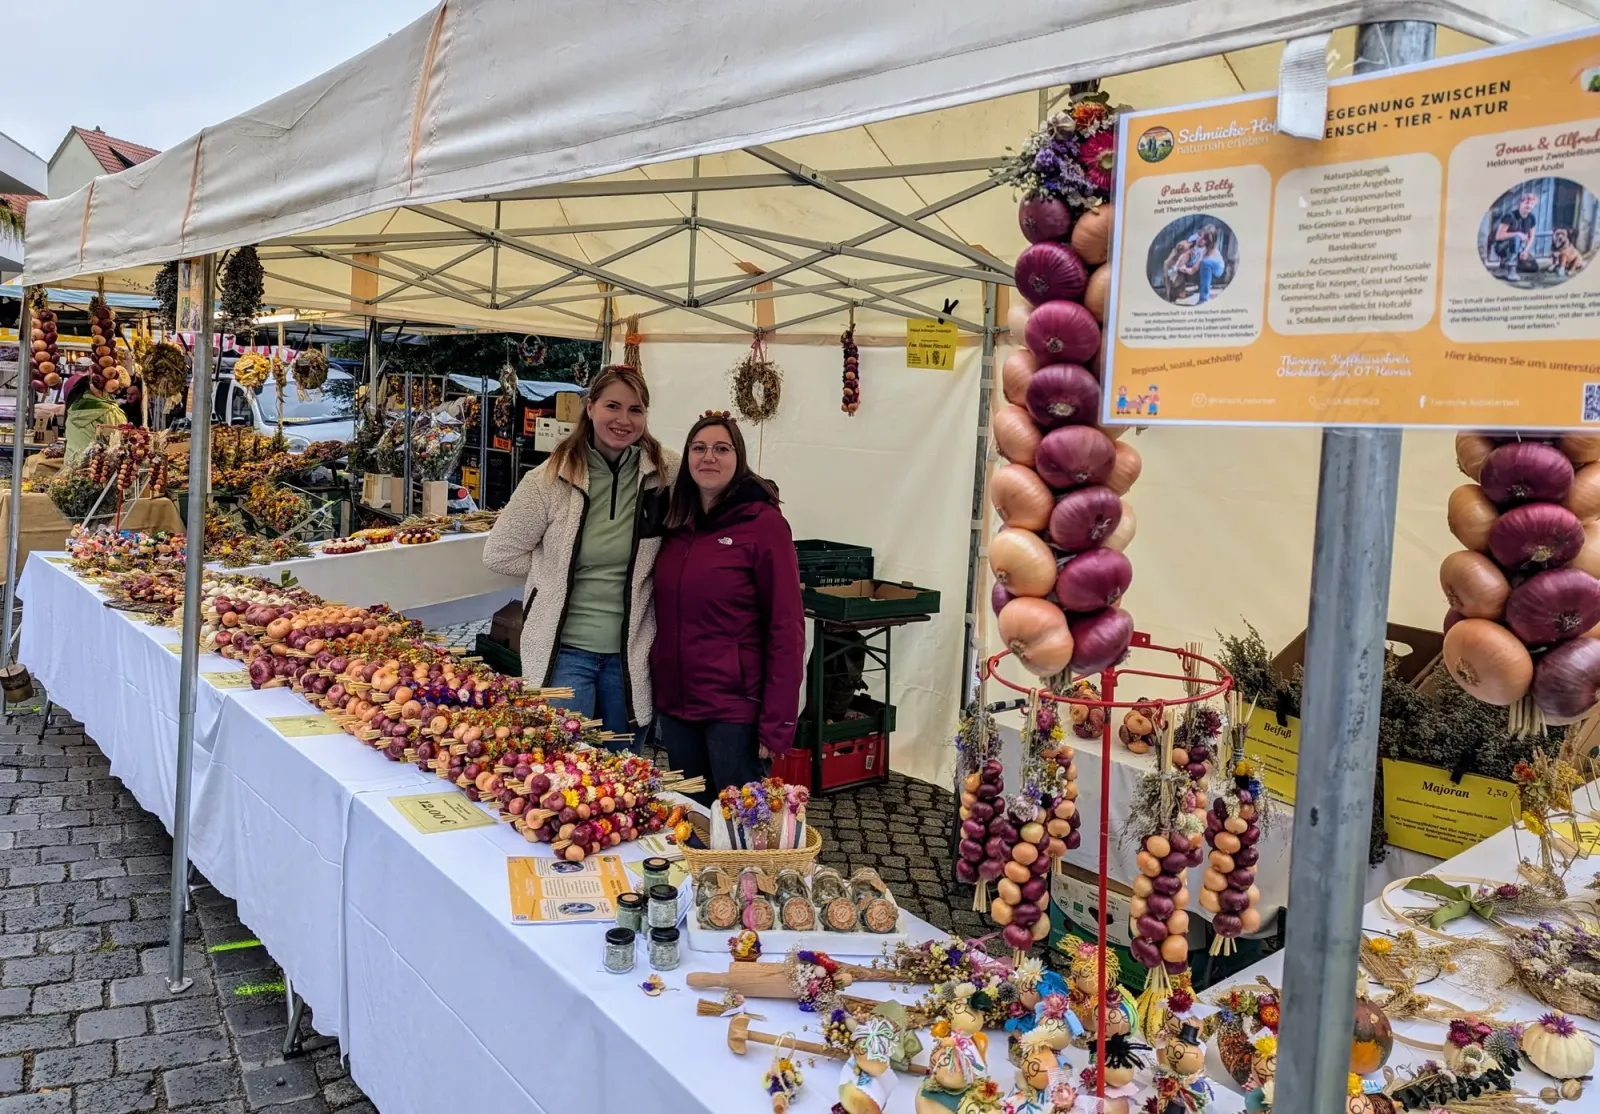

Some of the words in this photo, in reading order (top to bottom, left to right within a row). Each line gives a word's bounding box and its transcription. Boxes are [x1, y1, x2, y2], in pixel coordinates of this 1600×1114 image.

[1326, 97, 1415, 121] EGEGNUNG
[1421, 80, 1511, 106] ZWISCHEN
[1325, 121, 1377, 139] ENSCH
[1395, 112, 1431, 129] TIER
[1449, 100, 1509, 120] NATUR
[1176, 140, 1225, 155] naturnah
[1227, 134, 1269, 149] erleben
[1495, 142, 1536, 157] Jonas
[1537, 137, 1551, 149] &
[1487, 154, 1544, 168] Heldrungener
[1524, 164, 1538, 174] mit
[1323, 165, 1391, 181] Naturpädagogik
[1161, 184, 1190, 198] Paula
[1192, 182, 1201, 194] &
[1205, 178, 1234, 195] Betty
[1362, 177, 1405, 190] Angebote
[1157, 196, 1183, 206] kreative
[1310, 196, 1339, 206] soziale
[1339, 190, 1402, 204] Gruppenarbeit
[1153, 206, 1165, 215] mit
[1345, 202, 1405, 215] Kräutergarten
[1298, 220, 1347, 232] Bio-Gemüse
[1358, 213, 1412, 226] Permakultur
[1306, 231, 1341, 244] geführte
[1342, 227, 1402, 240] Wanderungen
[1327, 241, 1377, 253] Bastelkurse
[1370, 260, 1432, 275] psychosoziale
[1278, 282, 1314, 292] Beratung
[1362, 287, 1424, 299] Schulprojekte
[1131, 362, 1169, 376] Regional,
[1169, 358, 1196, 370] sozial,
[1196, 351, 1243, 366] nachhaltig!
[1444, 350, 1467, 360] Hier
[1468, 351, 1507, 365] können
[1508, 355, 1526, 367] Sie
[1527, 359, 1547, 369] uns
[1549, 360, 1600, 374] unterstüt
[1263, 722, 1293, 739] Beifuß
[1421, 781, 1470, 798] Majoran
[1486, 786, 1509, 798] 2,50
[417, 799, 447, 822] 12,00
